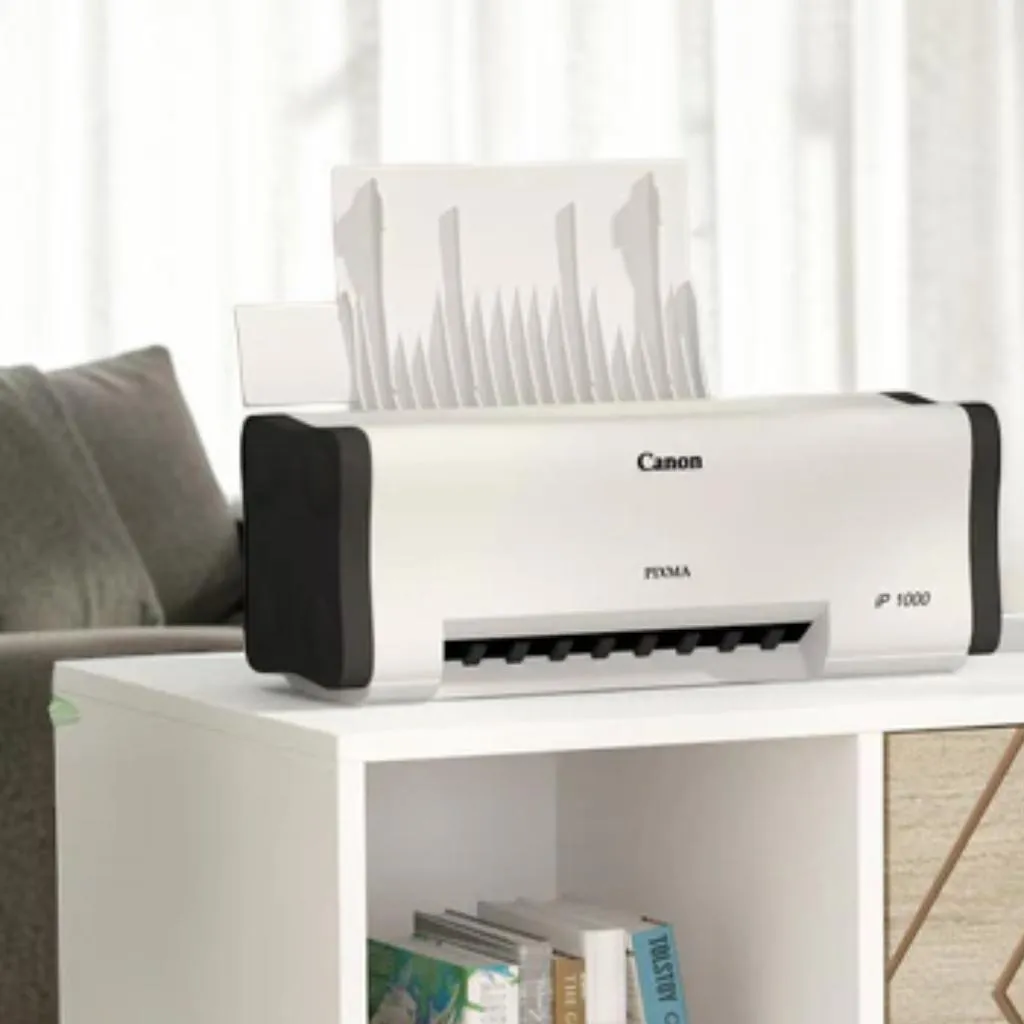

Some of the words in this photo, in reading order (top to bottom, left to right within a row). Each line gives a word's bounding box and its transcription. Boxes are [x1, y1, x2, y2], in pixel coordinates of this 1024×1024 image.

[637, 450, 703, 471] Canon
[643, 565, 691, 580] PIXMA
[896, 590, 932, 607] 1000
[647, 932, 679, 1002] TOLSTOY
